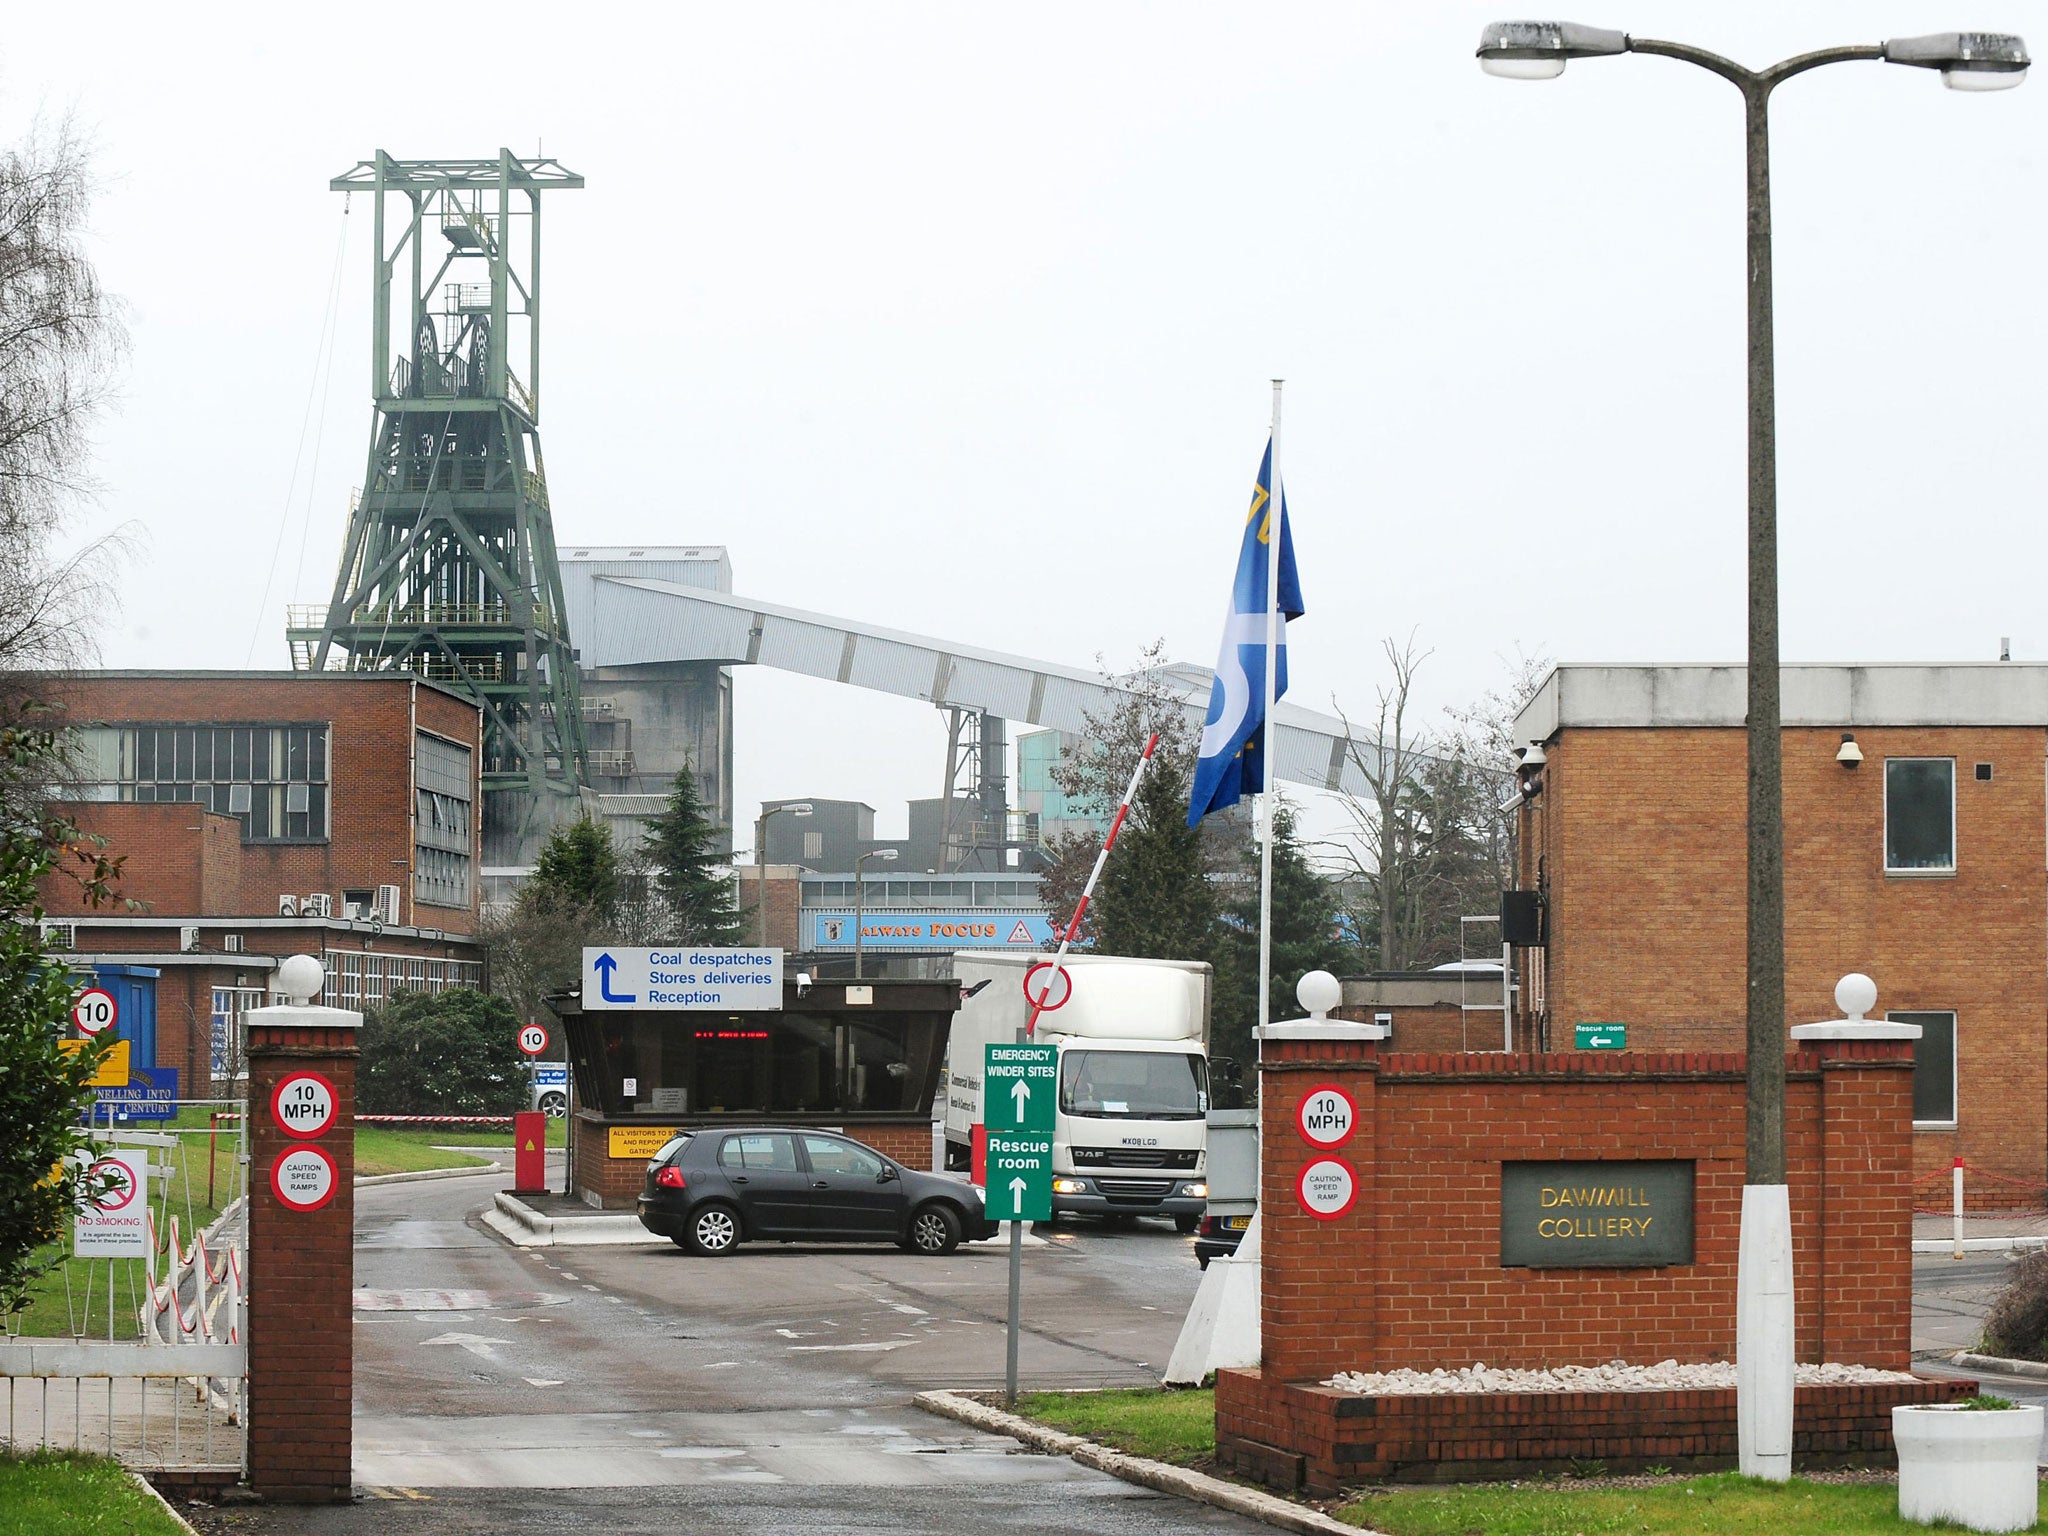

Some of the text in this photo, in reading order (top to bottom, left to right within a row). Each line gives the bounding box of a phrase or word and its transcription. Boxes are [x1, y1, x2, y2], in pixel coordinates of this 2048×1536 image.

[861, 925, 922, 937] ALWAYS
[929, 922, 997, 938] FOCUS
[649, 952, 772, 968] Coal despatches
[649, 971, 772, 984] Stores deliveries
[648, 990, 721, 1005] Reception
[83, 1003, 108, 1022] 10
[525, 1033, 542, 1045] 10
[991, 1049, 1050, 1061] EMERGENCY
[987, 1065, 1055, 1078] WINDER SITES
[147, 1089, 171, 1099] INTO
[295, 1086, 315, 1100] 10
[125, 1103, 171, 1113] CENTURY
[284, 1104, 325, 1118] MPH
[1317, 1099, 1335, 1112] 10
[1308, 1115, 1346, 1129] MPH
[989, 1138, 1049, 1153] Rescue
[1074, 1150, 1104, 1158] DAF
[998, 1158, 1040, 1169] room
[291, 1172, 317, 1180] SPEED
[290, 1183, 318, 1191] RAMPS
[1540, 1187, 1651, 1208] DAWMILL
[78, 1217, 143, 1226] NO SMOKING.
[1537, 1217, 1653, 1238] COLLIERY
